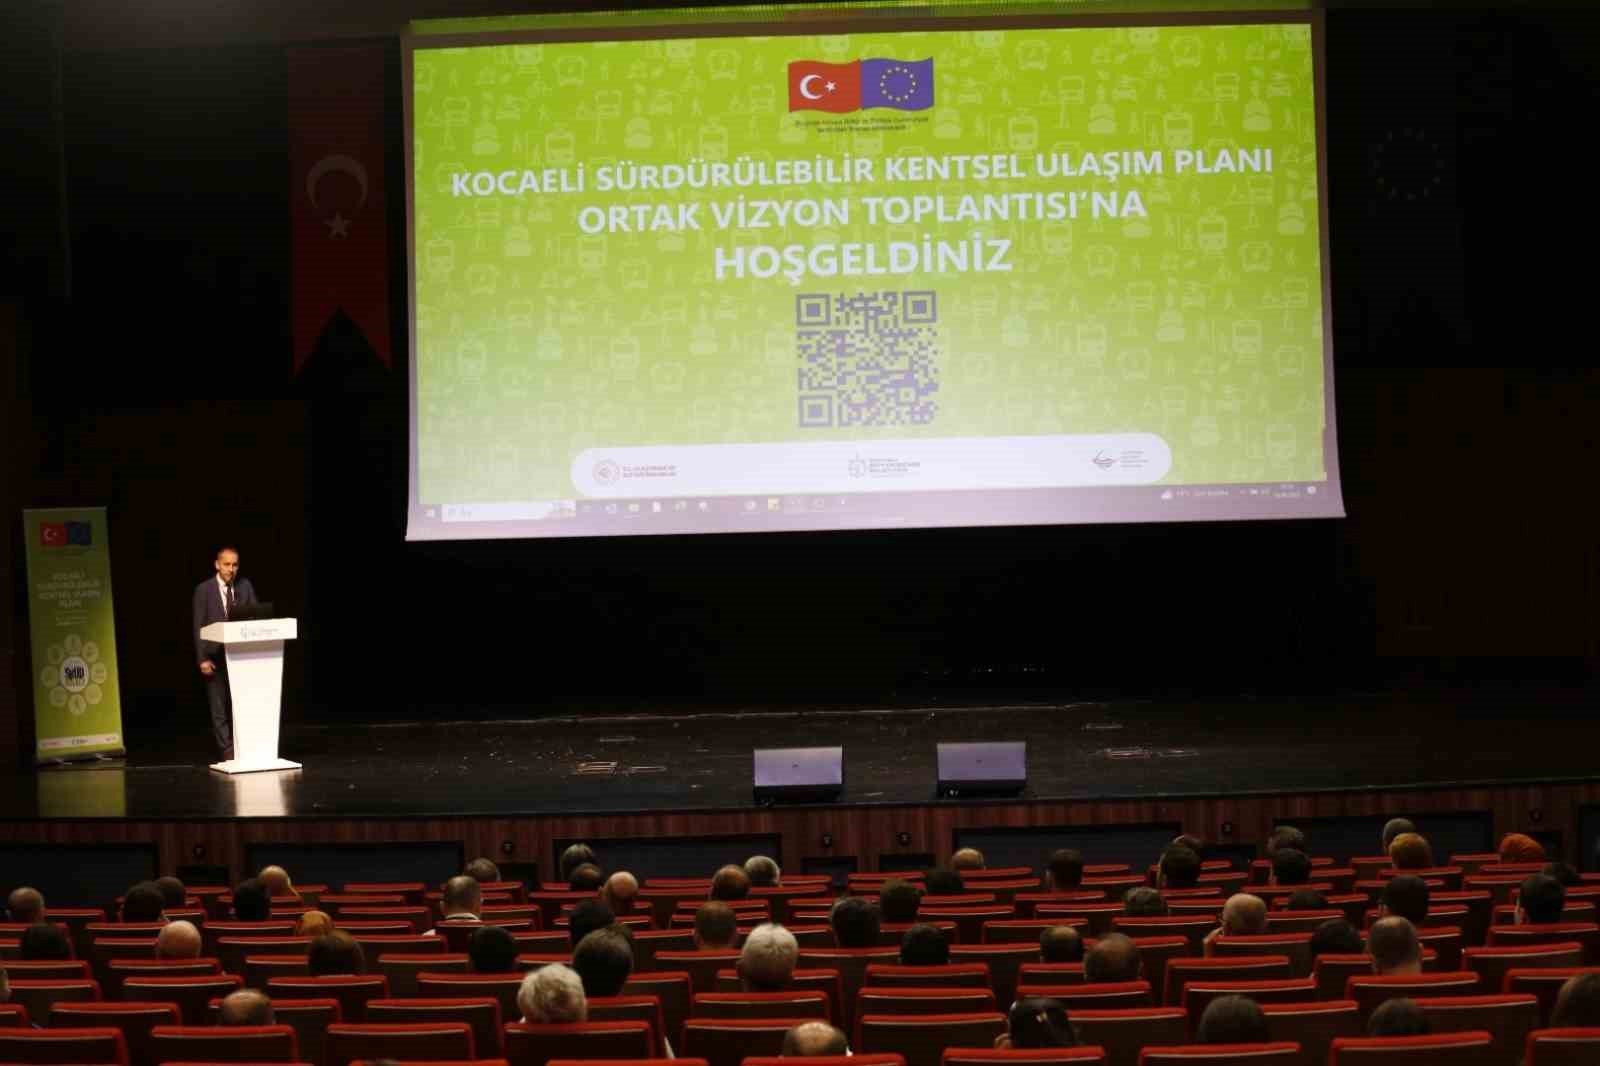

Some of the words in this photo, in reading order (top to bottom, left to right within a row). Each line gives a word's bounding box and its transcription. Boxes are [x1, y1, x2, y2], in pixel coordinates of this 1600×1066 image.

[451, 163, 585, 196] KOCAELİ
[596, 154, 875, 191] SÜRDÜRÜLEBİLİR
[885, 154, 1027, 182] KENTSEL
[1036, 150, 1163, 183] ULAŞIM
[1175, 148, 1273, 173] PLANI
[577, 203, 700, 234] ORTAK
[709, 194, 850, 230] VİZYON
[860, 190, 1147, 225] TOPLANTISI'NA
[715, 230, 1013, 287] HOŞGELDİNİZ
